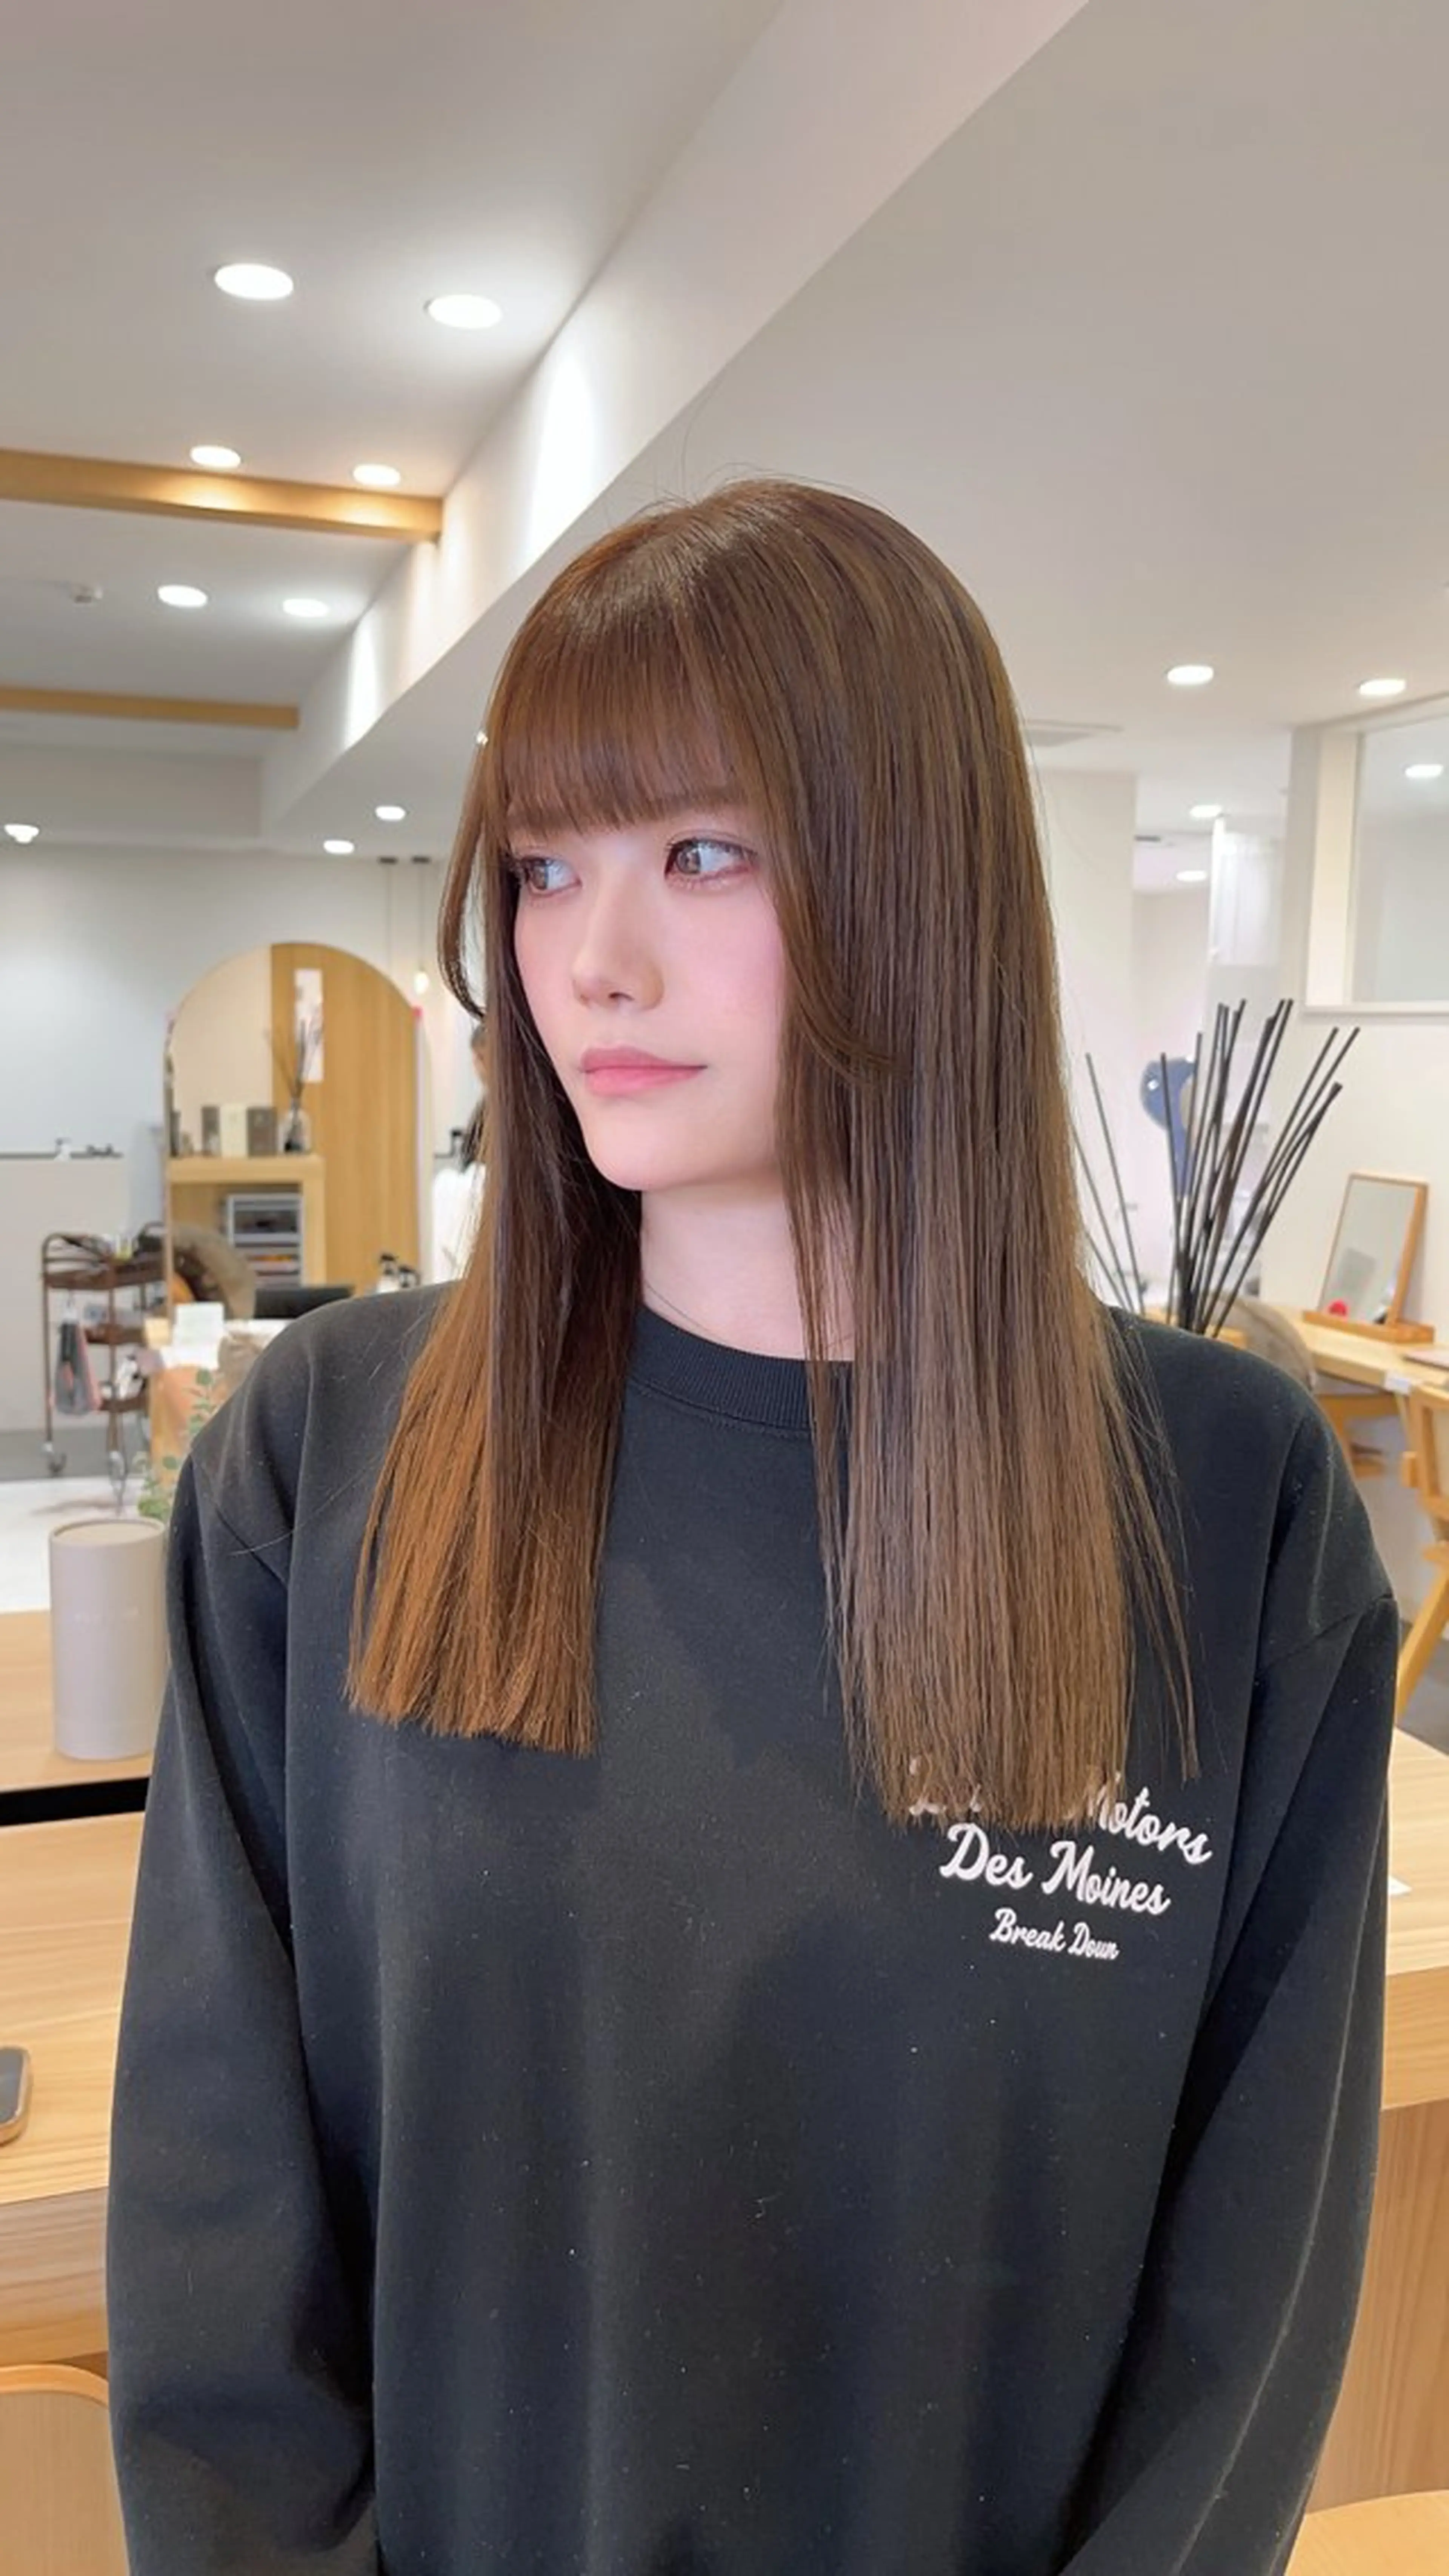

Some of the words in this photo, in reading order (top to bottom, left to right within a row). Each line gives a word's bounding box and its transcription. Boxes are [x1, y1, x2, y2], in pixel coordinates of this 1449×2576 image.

[939, 1822, 1034, 1890] Des
[1041, 1840, 1172, 1915] Moines
[989, 1907, 1067, 1953] Break
